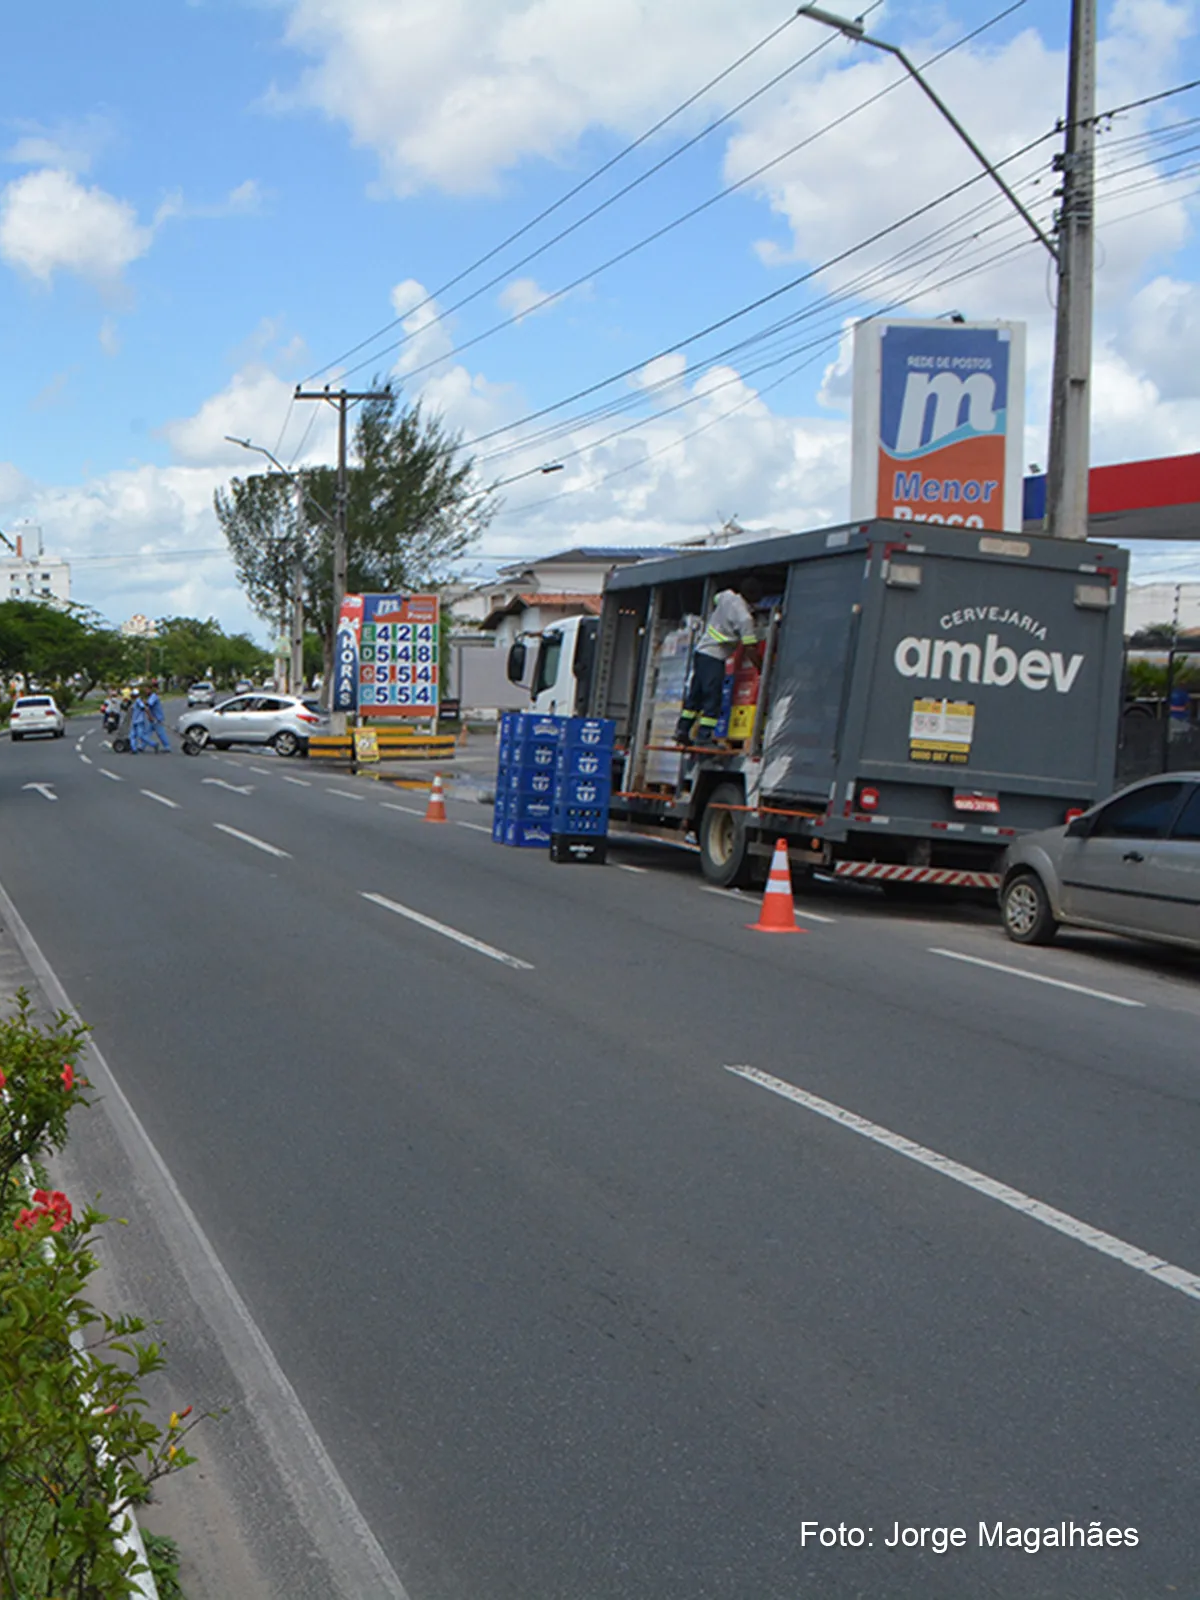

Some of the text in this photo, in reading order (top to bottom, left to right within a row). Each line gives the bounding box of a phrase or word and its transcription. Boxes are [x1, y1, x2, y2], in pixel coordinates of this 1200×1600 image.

[907, 355, 993, 370] REDE DE POSTOS
[892, 470, 998, 503] Menor
[939, 605, 1048, 641] CERVEJARIA
[340, 635, 354, 705] HORAS
[894, 633, 1085, 694] ambev
